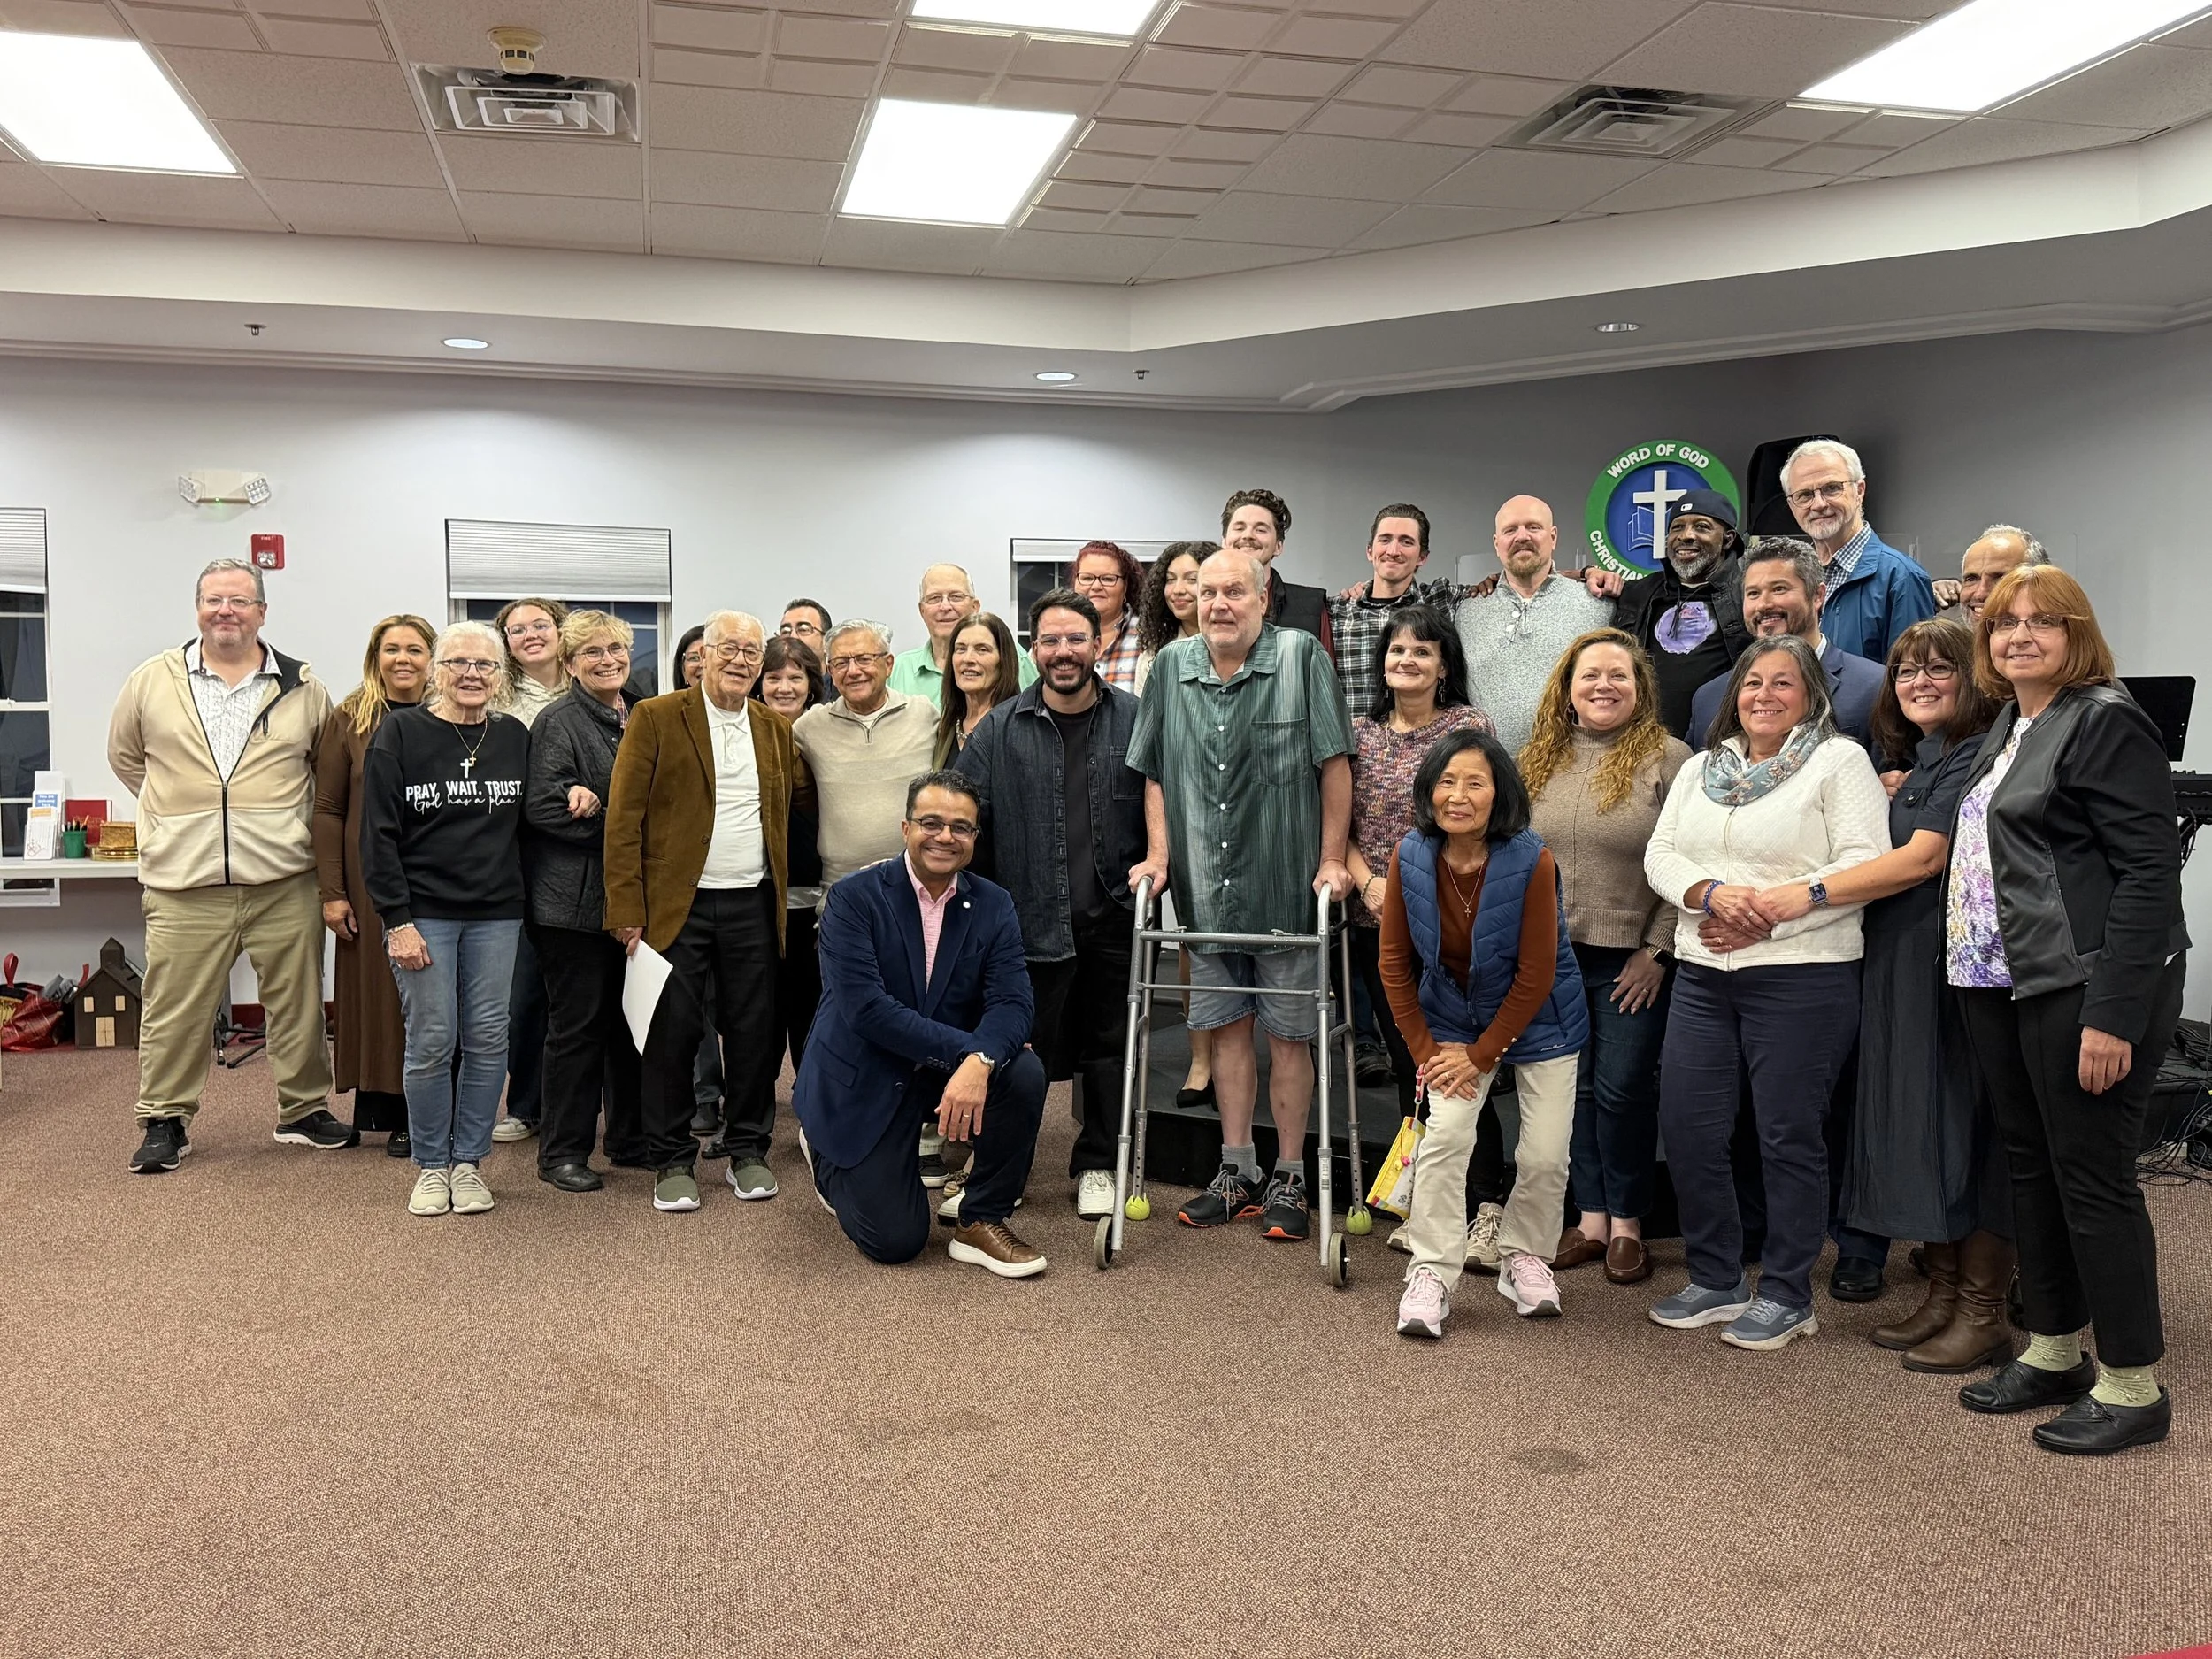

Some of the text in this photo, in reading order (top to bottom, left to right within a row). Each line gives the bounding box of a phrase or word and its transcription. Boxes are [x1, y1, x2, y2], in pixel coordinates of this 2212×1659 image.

[1607, 443, 1709, 478] WORD OF GOD
[445, 780, 482, 796] WAIT.
[414, 792, 443, 815] God
[447, 793, 472, 806] has
[488, 793, 516, 814] plan
